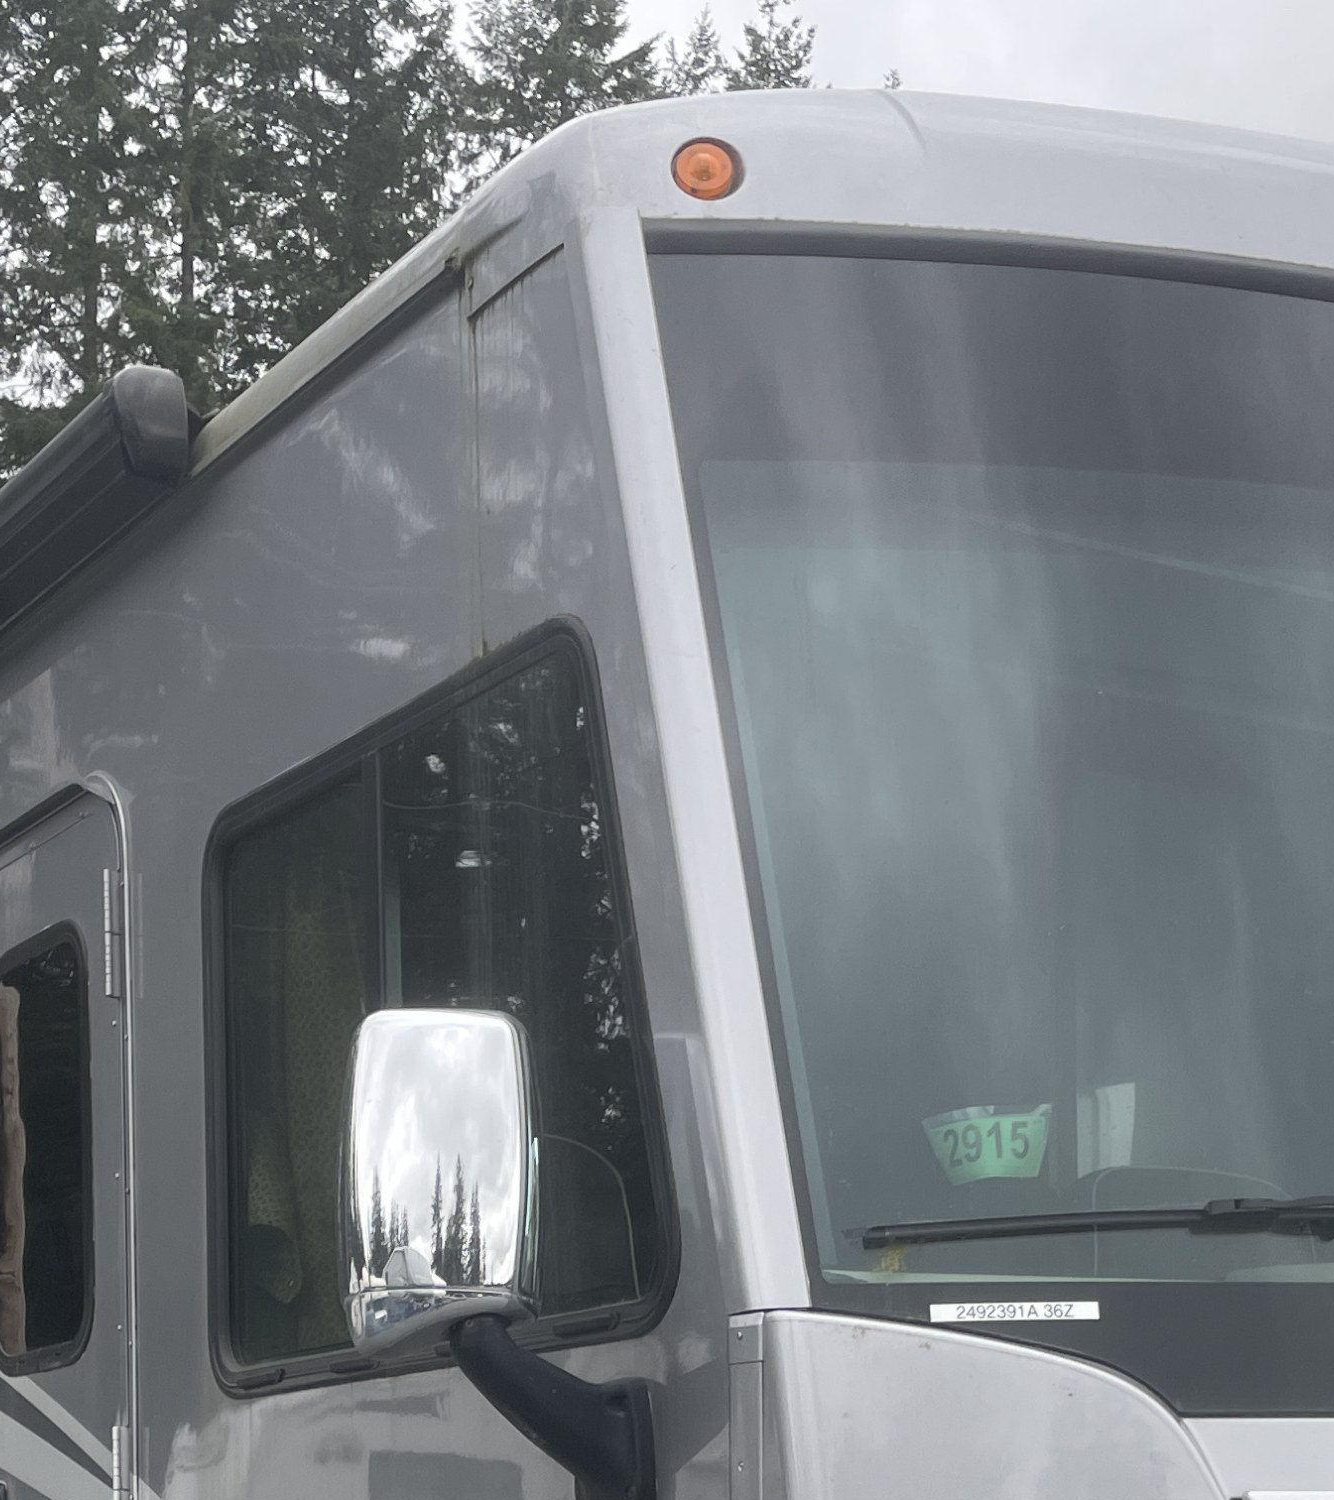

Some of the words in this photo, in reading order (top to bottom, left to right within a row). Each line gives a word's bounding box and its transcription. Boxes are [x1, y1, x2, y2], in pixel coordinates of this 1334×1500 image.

[943, 1120, 1030, 1168] 2915
[955, 1304, 1040, 1320] 2492391A
[1043, 1303, 1075, 1319] 36Z
